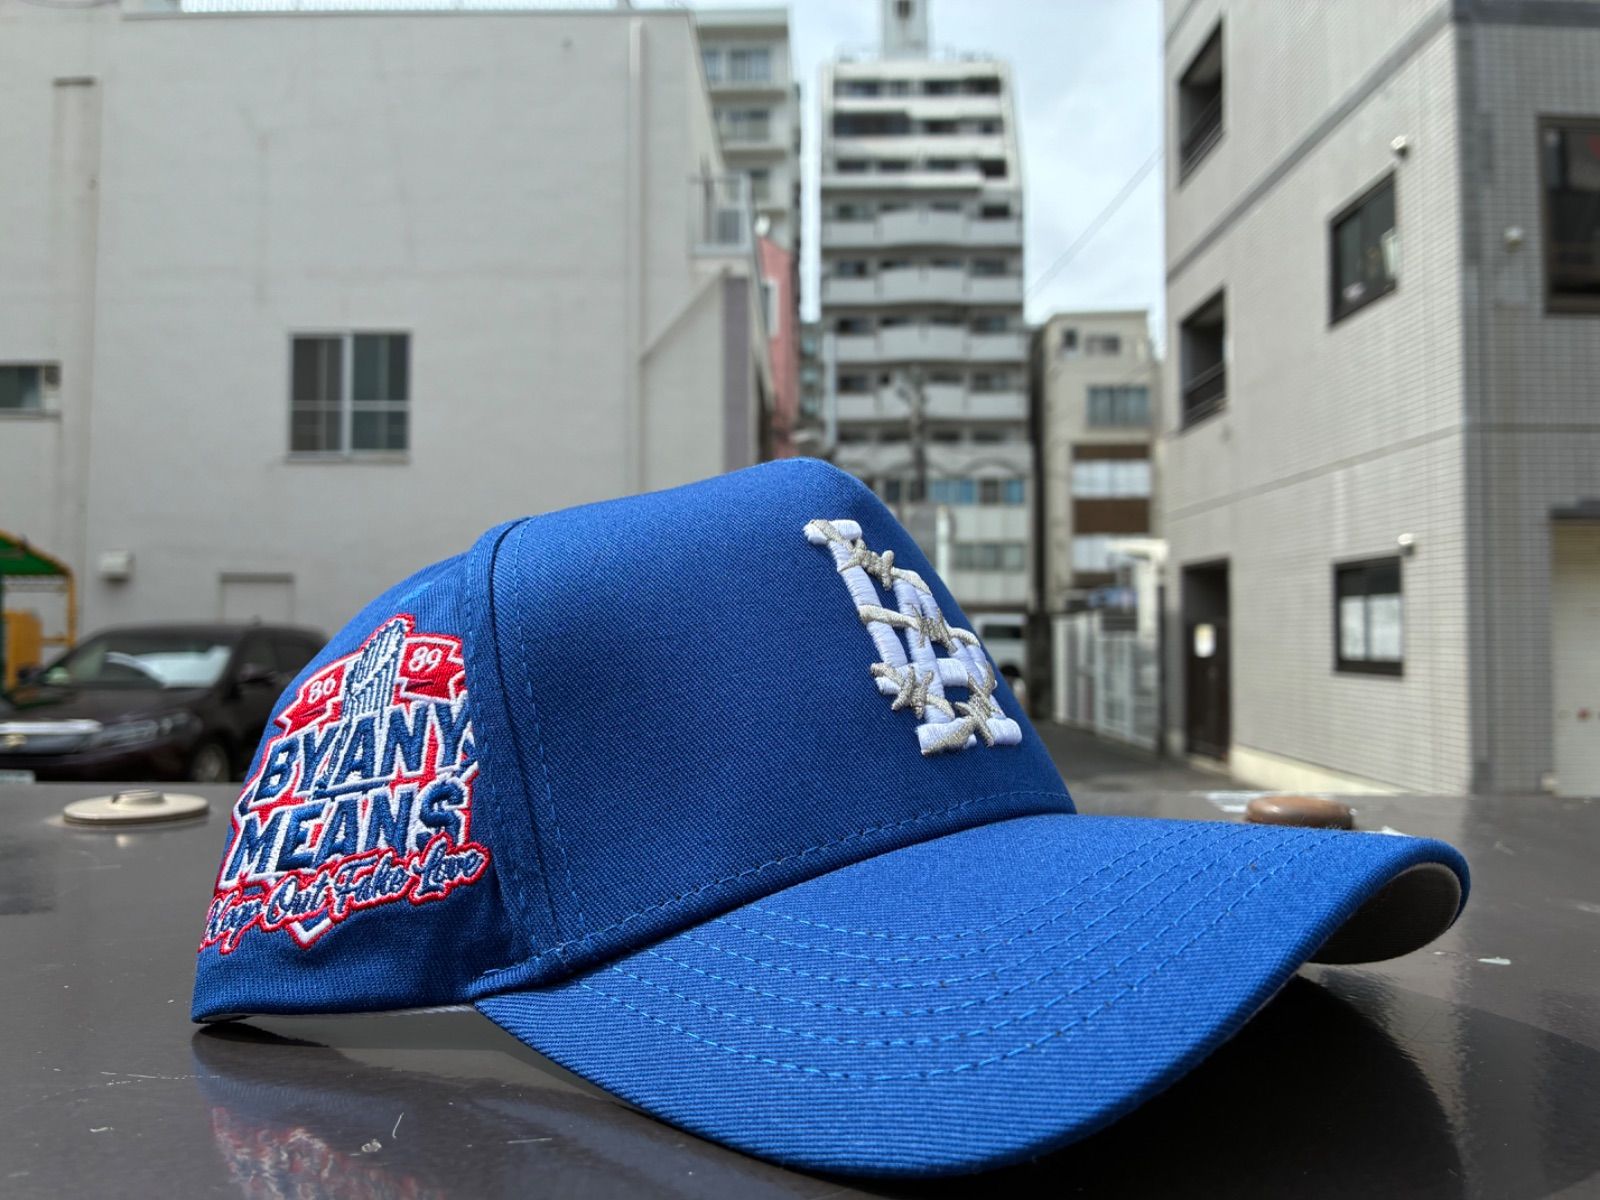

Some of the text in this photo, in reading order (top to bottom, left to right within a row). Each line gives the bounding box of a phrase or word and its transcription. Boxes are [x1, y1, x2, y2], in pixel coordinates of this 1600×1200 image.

[408, 647, 443, 672] 89
[225, 780, 468, 883] MEANS
[267, 873, 329, 923] Out
[334, 855, 409, 913] Fake
[412, 840, 483, 898] Love
